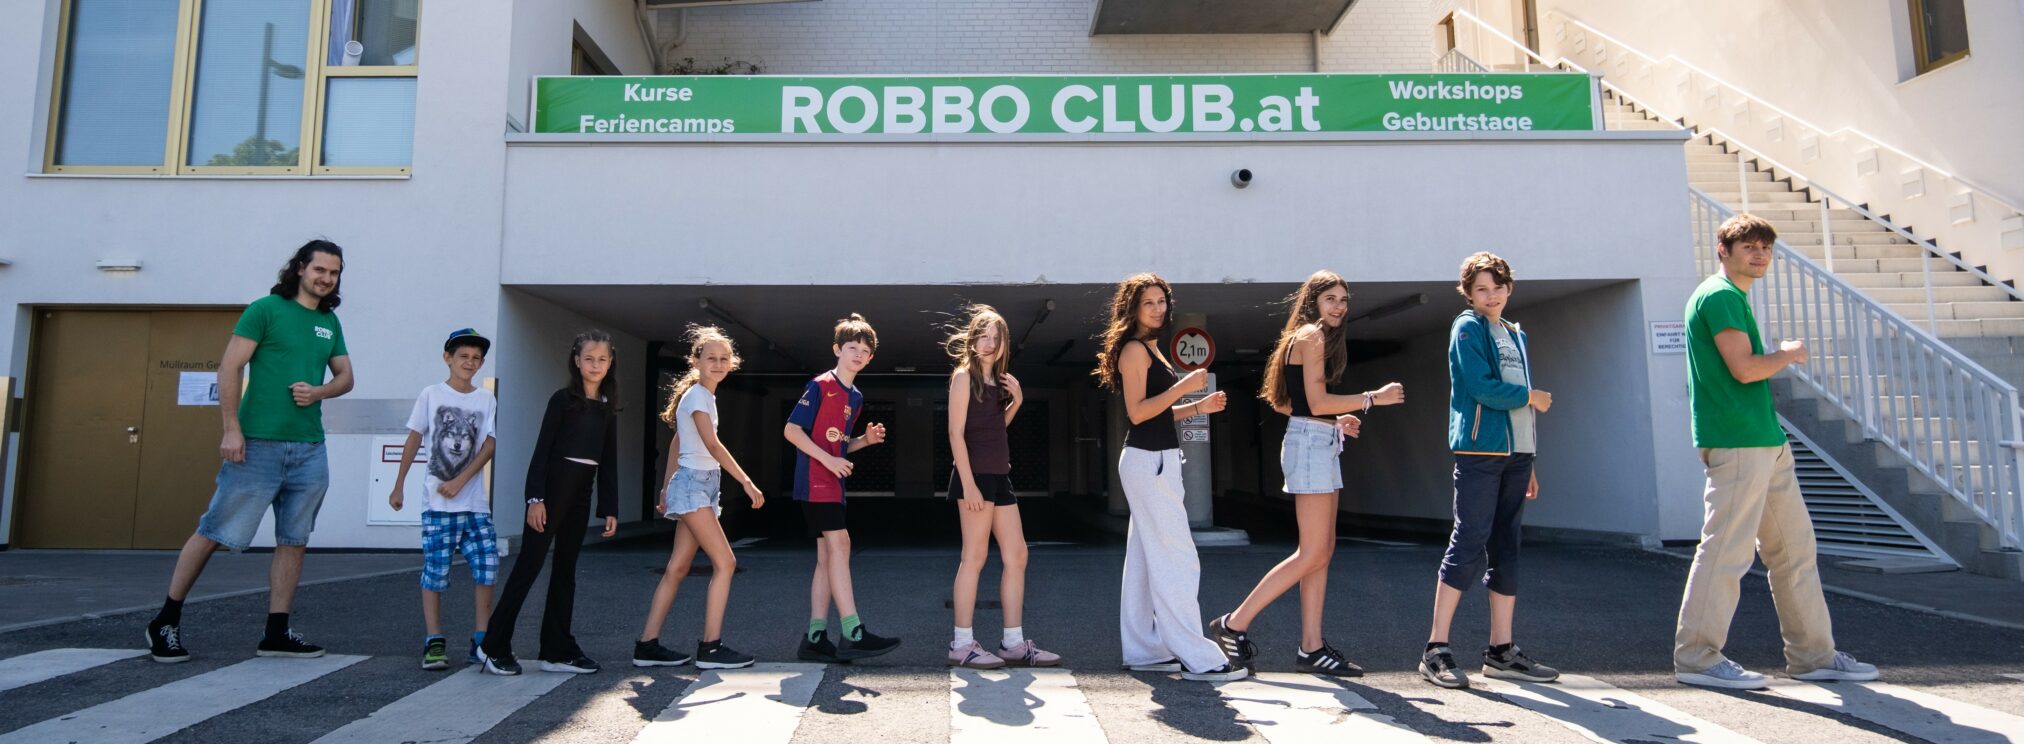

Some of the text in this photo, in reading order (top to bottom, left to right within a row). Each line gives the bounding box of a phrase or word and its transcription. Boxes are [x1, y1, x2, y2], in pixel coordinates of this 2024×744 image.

[624, 83, 693, 102] Kurse
[1388, 80, 1523, 104] Workshops
[781, 83, 1321, 134] ROBBO CLUB.at
[580, 113, 735, 133] Feriencamps
[1382, 112, 1532, 131] Geburtstage
[159, 360, 204, 369] Müllraum
